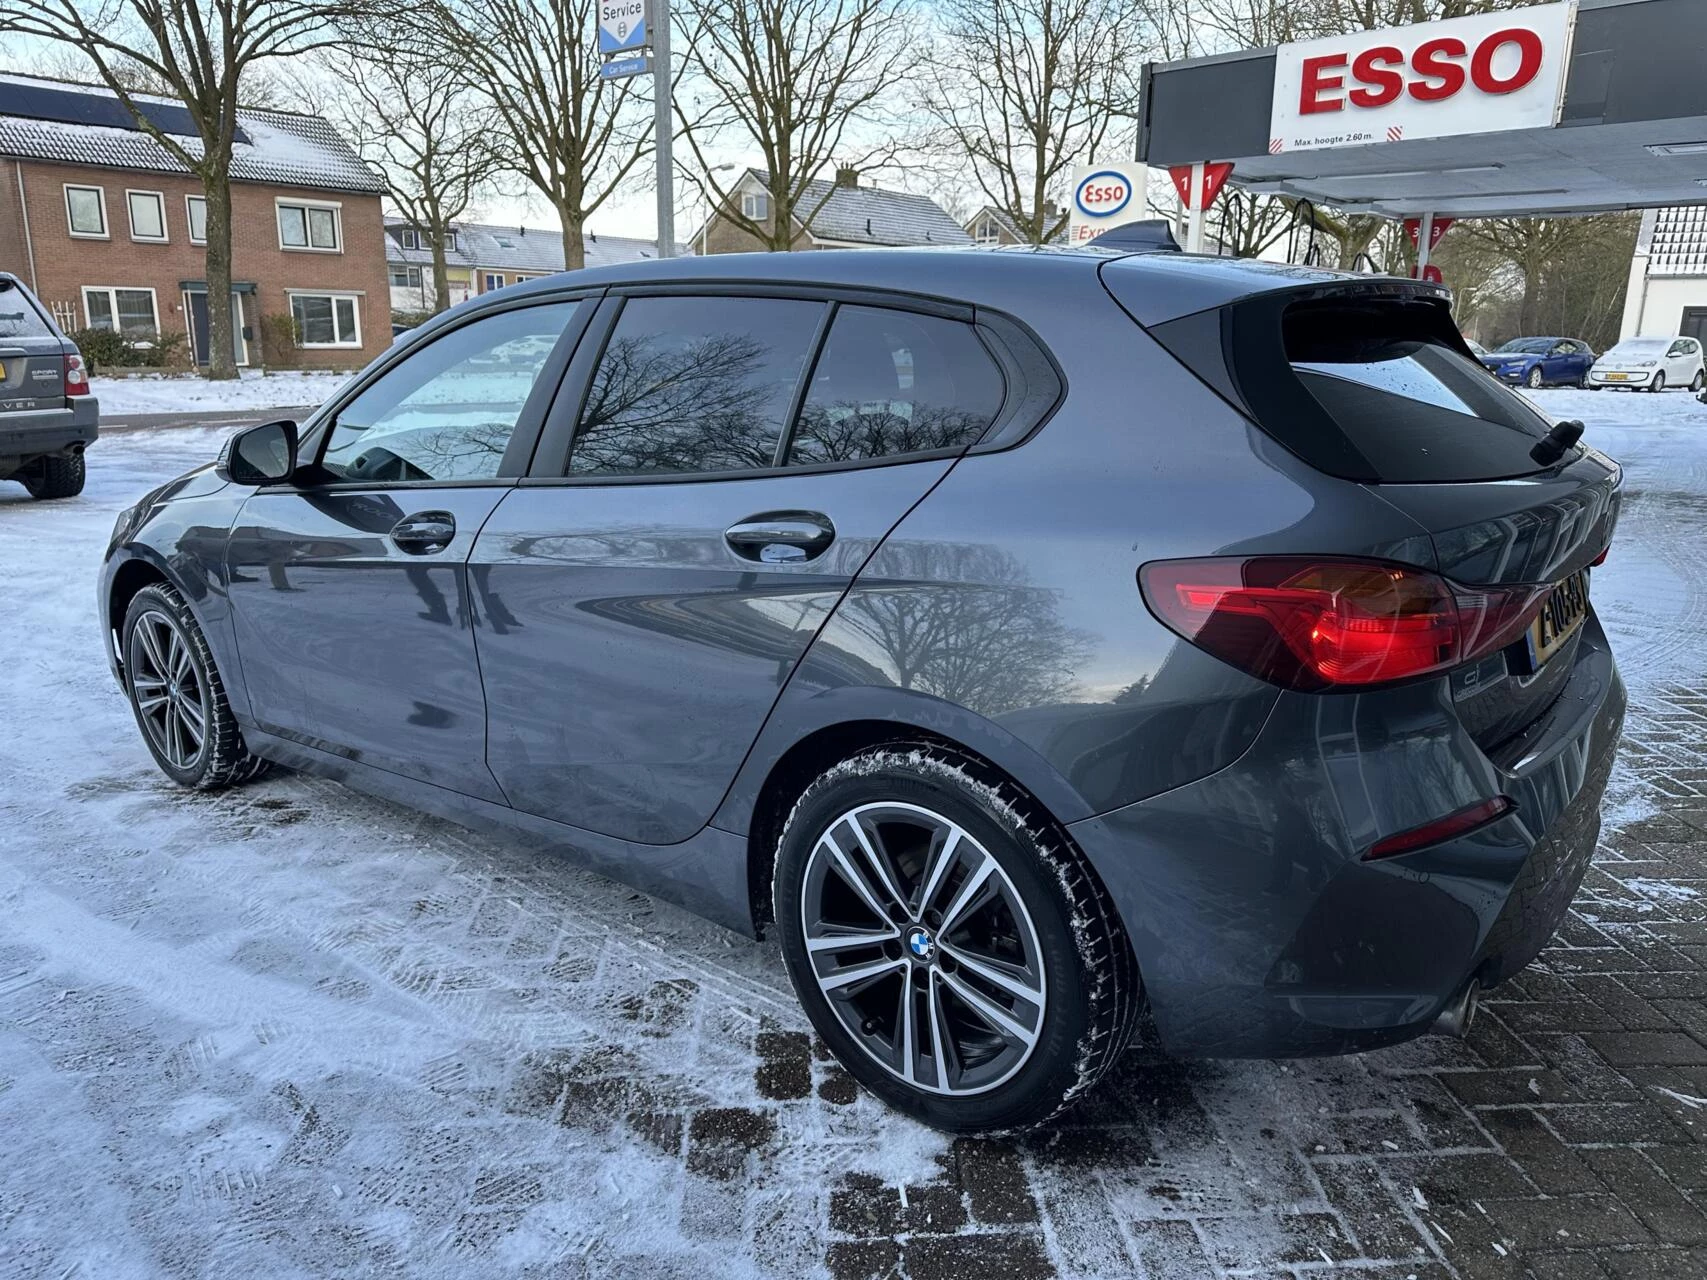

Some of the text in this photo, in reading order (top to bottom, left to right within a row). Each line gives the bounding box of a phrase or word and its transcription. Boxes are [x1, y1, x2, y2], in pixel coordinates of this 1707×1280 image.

[603, 3, 642, 20] Service
[1299, 28, 1544, 115] ESSO
[1315, 136, 1344, 145] hoogte
[1345, 133, 1363, 142] 2.60
[1181, 176, 1188, 191] 1
[1205, 175, 1212, 190] 1
[1085, 184, 1124, 203] Esso
[1412, 227, 1420, 238] 3
[1432, 226, 1441, 237] 3
